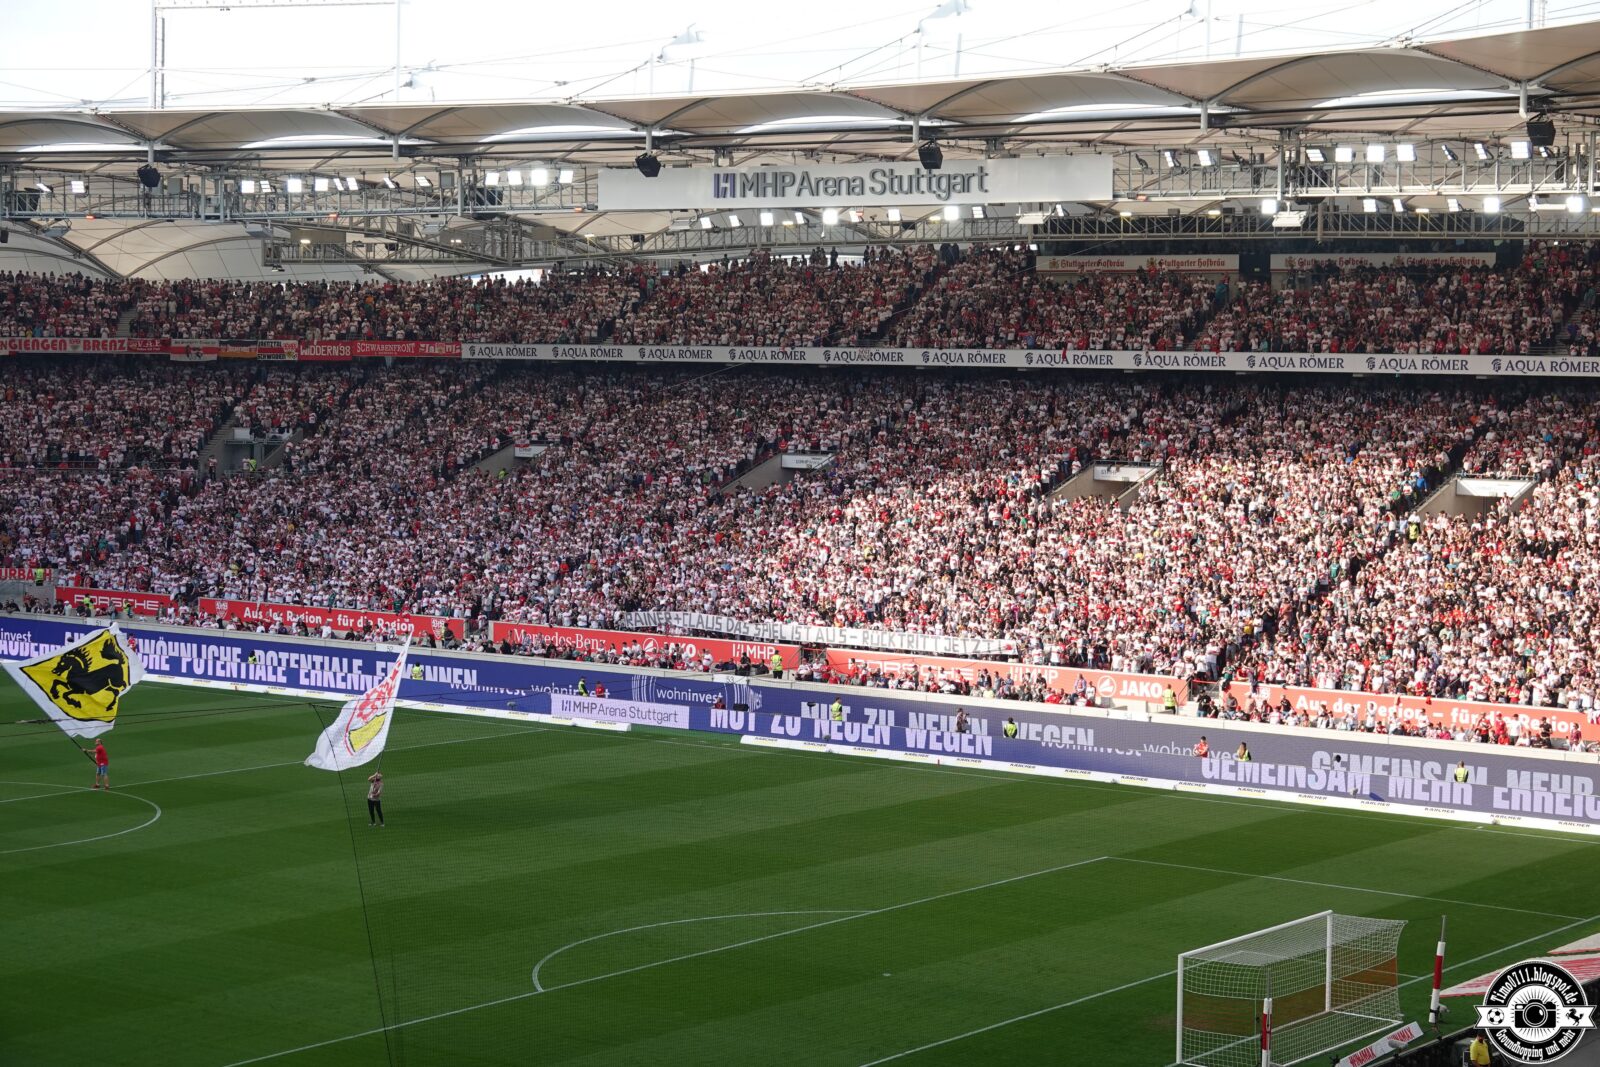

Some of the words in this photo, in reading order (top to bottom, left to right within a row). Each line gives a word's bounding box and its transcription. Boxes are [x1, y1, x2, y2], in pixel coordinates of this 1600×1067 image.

[869, 165, 989, 200] Stuttgart
[82, 339, 126, 351] BRENZ
[478, 346, 504, 356] AQUA
[505, 345, 537, 356] RÖMER
[561, 347, 588, 357] AQUA
[590, 346, 623, 357] RÖMER
[648, 348, 676, 359] AQUA
[679, 347, 712, 358] RÖMER
[738, 350, 768, 360] AQUA
[932, 352, 964, 363] AQUA
[968, 351, 1007, 363] RÖMER
[1073, 352, 1113, 364] RÖMER
[1145, 355, 1180, 367] AQUA
[1184, 354, 1226, 366] RÖMER
[1259, 357, 1296, 369] AQUA
[1300, 355, 1344, 368] RÖMER
[1379, 358, 1417, 370] AQUA
[1422, 357, 1468, 369] RÖMER
[1505, 360, 1546, 372] AQUA
[1550, 358, 1600, 371] RÖMER
[0, 568, 52, 581] URBAH
[244, 607, 262, 619] Aus
[337, 614, 354, 627] für
[726, 618, 749, 635] DAS
[755, 623, 786, 640] SPIEL
[791, 625, 811, 641] IST
[513, 628, 606, 650] Meredes-Benz
[746, 645, 776, 660] MHP
[299, 667, 383, 692] ERKENNE
[375, 660, 477, 686] ERKNNEN
[530, 682, 611, 699] wohninet
[656, 687, 724, 704] wohninvest
[1120, 680, 1163, 698] JAKO
[628, 706, 679, 724] Stuttgart
[908, 711, 988, 736] NEUN
[1486, 711, 1512, 728] de
[1517, 713, 1580, 733] Reion
[905, 728, 992, 756] WEGEN
[1201, 757, 1371, 795] GEMEINSAM
[1311, 750, 1488, 786] GEMEINSAM
[1506, 769, 1593, 796] MEHR
